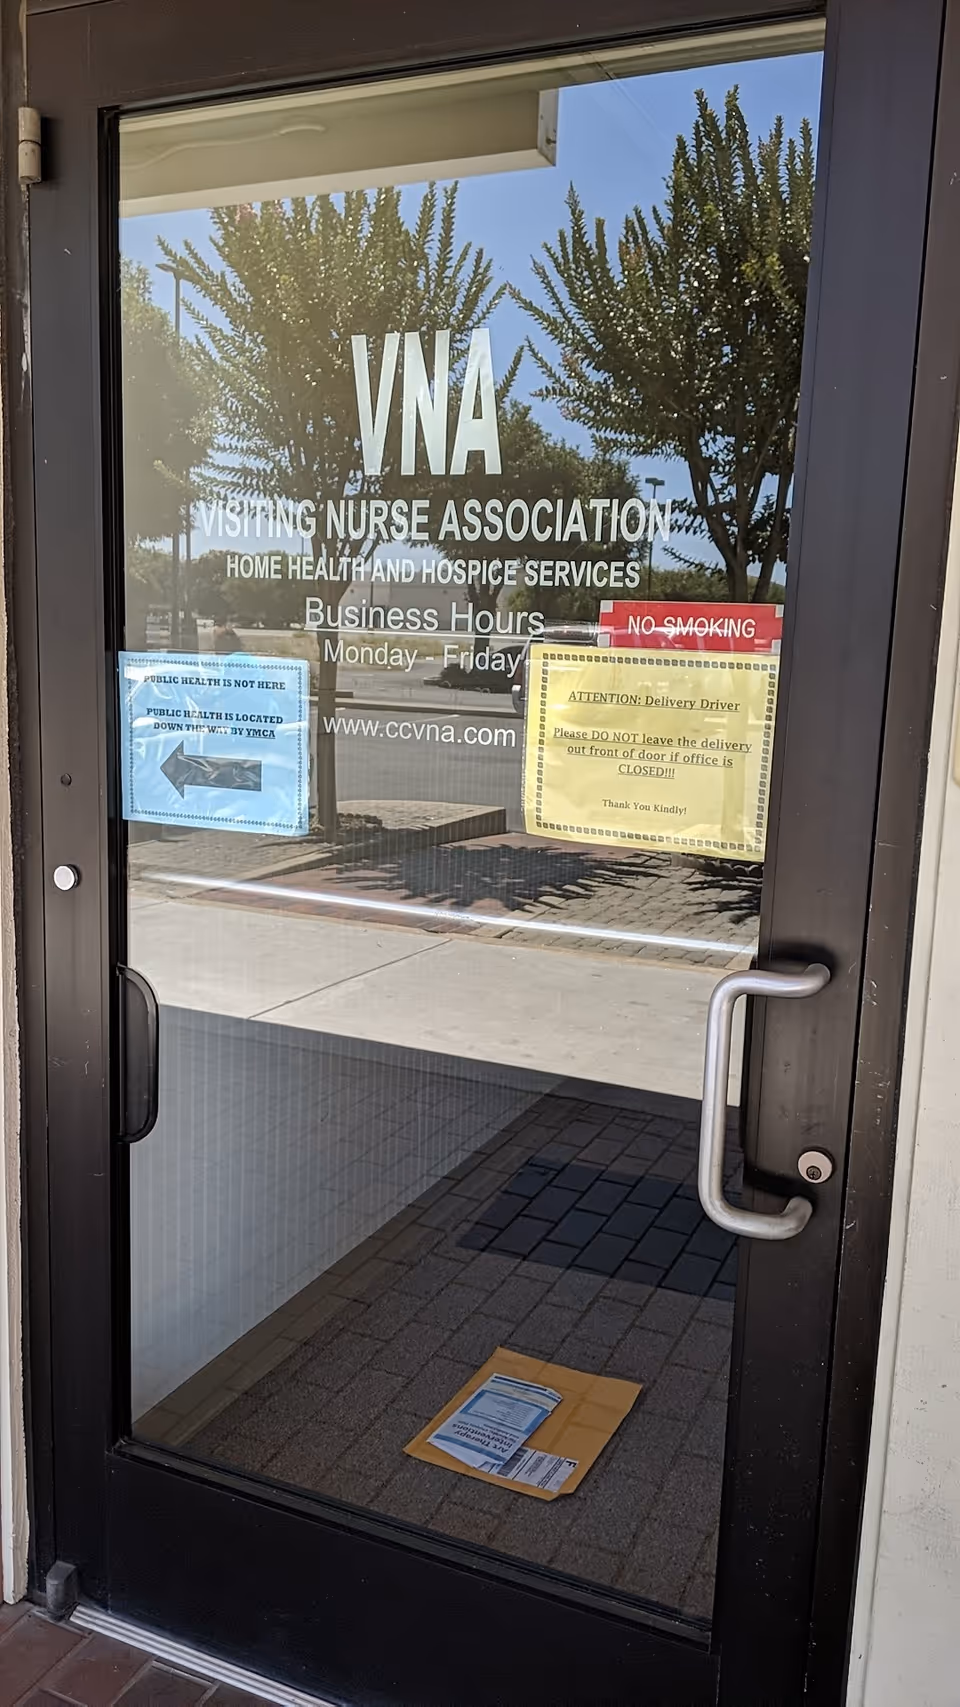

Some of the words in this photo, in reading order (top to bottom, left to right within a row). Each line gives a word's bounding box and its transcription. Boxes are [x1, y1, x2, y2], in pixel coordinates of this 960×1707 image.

[350, 327, 502, 477] VNA
[197, 500, 317, 539] VISITING
[326, 499, 430, 541] NURSE
[438, 498, 674, 543] ASSOCIATION
[226, 555, 283, 580] HOME
[288, 555, 366, 582] HEALTH
[371, 558, 415, 584] AND
[421, 559, 517, 587] HOSPICE
[523, 560, 641, 589] SERVICES
[305, 596, 439, 631] Business
[450, 601, 546, 636] Hours
[627, 615, 656, 635] NO
[663, 616, 757, 638] SMOKING
[324, 639, 418, 672] Monday
[443, 644, 523, 679] Friday
[143, 675, 179, 685] PUBLIC
[181, 676, 221, 687] HEALTH
[223, 679, 232, 687] IS
[234, 679, 256, 689] NOT
[257, 680, 286, 690] HERE
[568, 691, 642, 705] ATTENTION:
[645, 695, 697, 710] Delivery
[699, 699, 741, 711] Driver
[146, 707, 182, 718] PUBLIC
[183, 709, 223, 720] HEALTH
[224, 711, 234, 721] IS
[235, 713, 284, 724] LOCATED
[153, 721, 183, 732] DOWN
[185, 723, 205, 733] THE
[207, 725, 229, 735] WAY
[231, 727, 245, 736] BY
[246, 728, 276, 738] YMCA
[322, 716, 517, 748] www.ccvna.com
[553, 727, 588, 739] Please
[591, 730, 610, 741] DO
[613, 731, 640, 743] NOT
[642, 733, 674, 746] leave
[677, 736, 697, 747] the
[701, 738, 752, 753] delivery
[567, 745, 586, 755] out
[589, 745, 619, 757] front
[622, 748, 635, 759] of
[638, 749, 667, 761] door
[670, 751, 679, 762] if
[682, 753, 719, 765] office
[722, 755, 734, 767] is
[617, 764, 676, 778] CLOSED!!!
[602, 799, 631, 810] Thank
[633, 801, 651, 811] You
[653, 803, 687, 815] Kindly!
[452, 1423, 513, 1449] Interventions
[454, 1430, 490, 1447] Therapy
